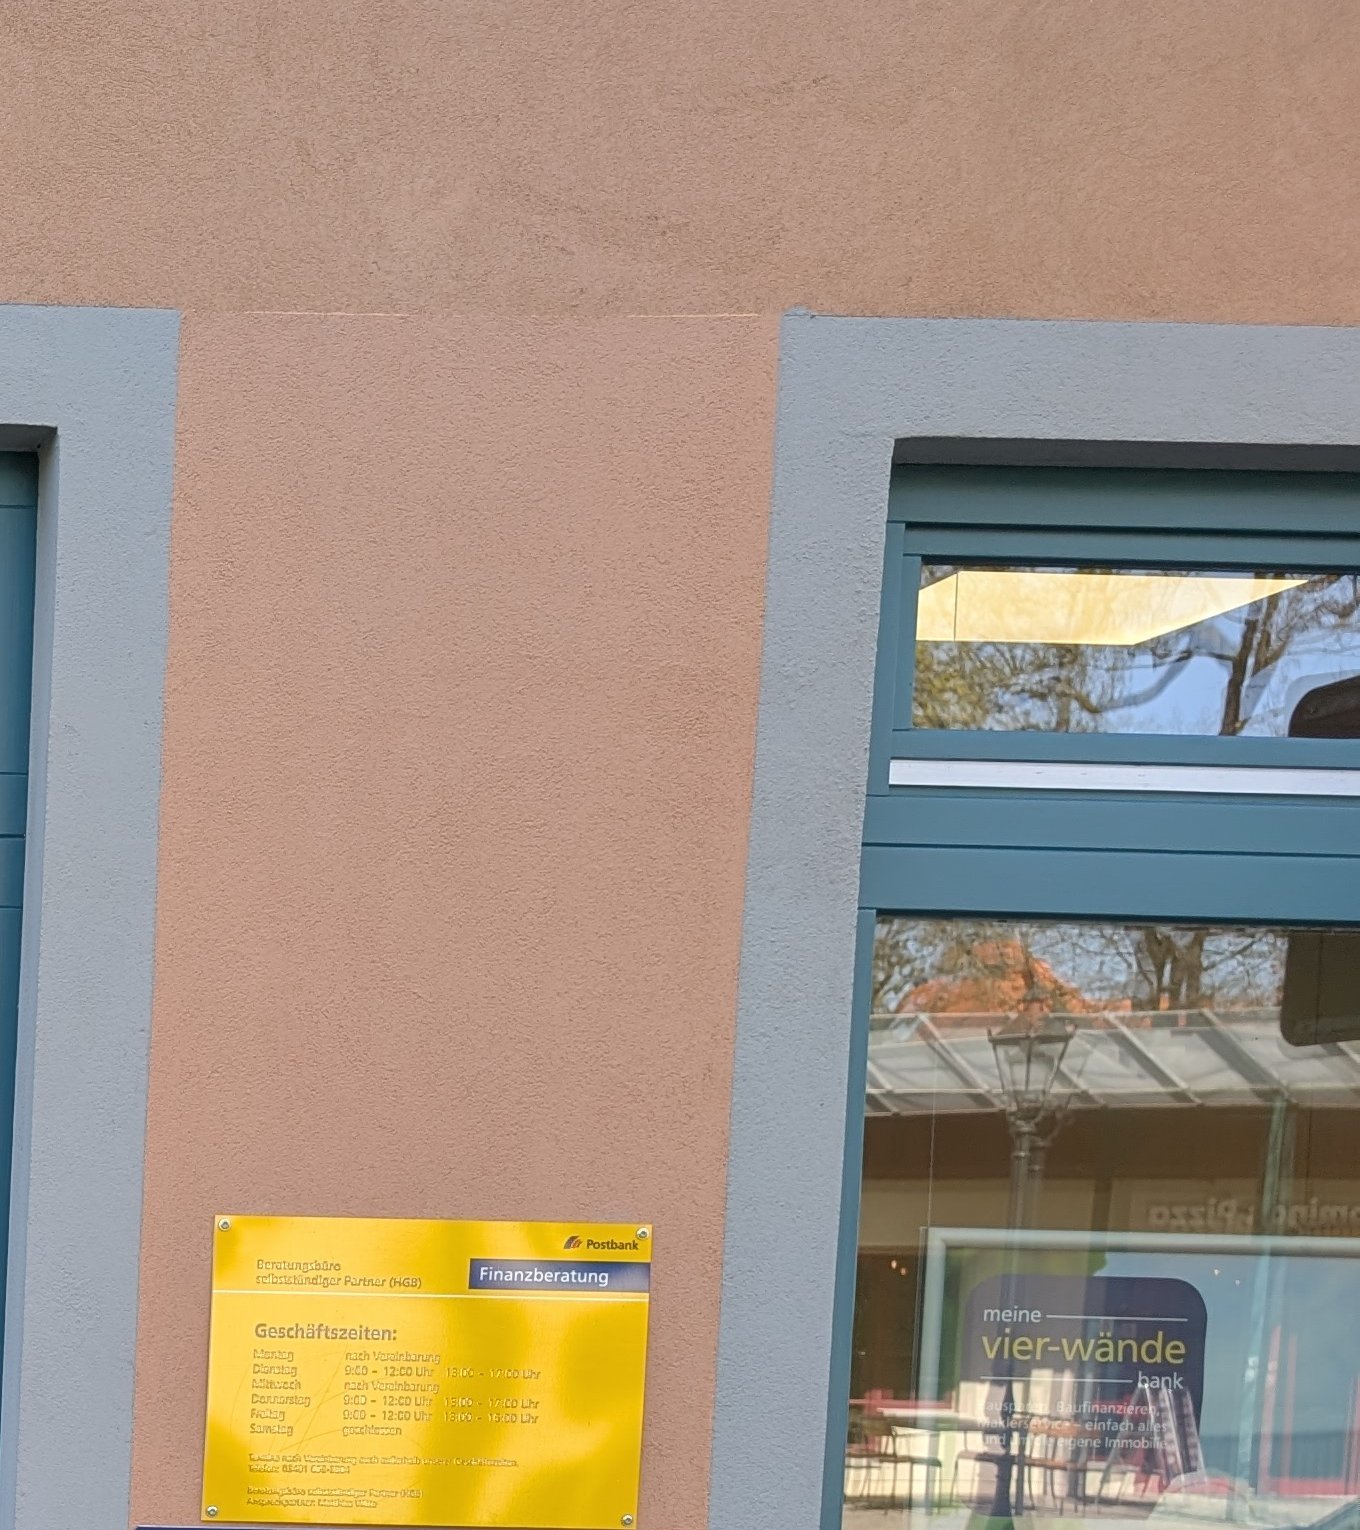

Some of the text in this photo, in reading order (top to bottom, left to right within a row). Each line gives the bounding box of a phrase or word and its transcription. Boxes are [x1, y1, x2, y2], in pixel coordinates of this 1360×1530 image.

[586, 1239, 639, 1250] Postbank
[256, 1259, 341, 1273] Beratungsbüro
[344, 1275, 422, 1289] Partner (HGB)
[479, 1266, 609, 1287] Finanzberatung
[983, 1306, 1042, 1323] meine
[255, 1323, 397, 1341] Geschäftszeiten:
[981, 1328, 1186, 1364] vier-wände
[253, 1350, 441, 1365] Montag nach Vereinbarung
[253, 1364, 541, 1380] Dienstag 9:00 12:00 Uhr Uhr
[252, 1379, 440, 1394] Mittwoch nach Vereinbarung
[1138, 1371, 1184, 1389] bank
[251, 1394, 540, 1409] Donnerstag 9:00 12:00 Uhr Uhr
[250, 1408, 285, 1422] Freitag
[343, 1410, 366, 1420] 9:00
[381, 1411, 411, 1421] 12:00
[413, 1411, 433, 1422] Uhr
[520, 1413, 539, 1424] Uhr
[250, 1423, 402, 1437] Samstag geschlossen
[1085, 1419, 1134, 1432] einfach
[1137, 1420, 1168, 1432] alles
[1055, 1437, 1102, 1449] eigene
